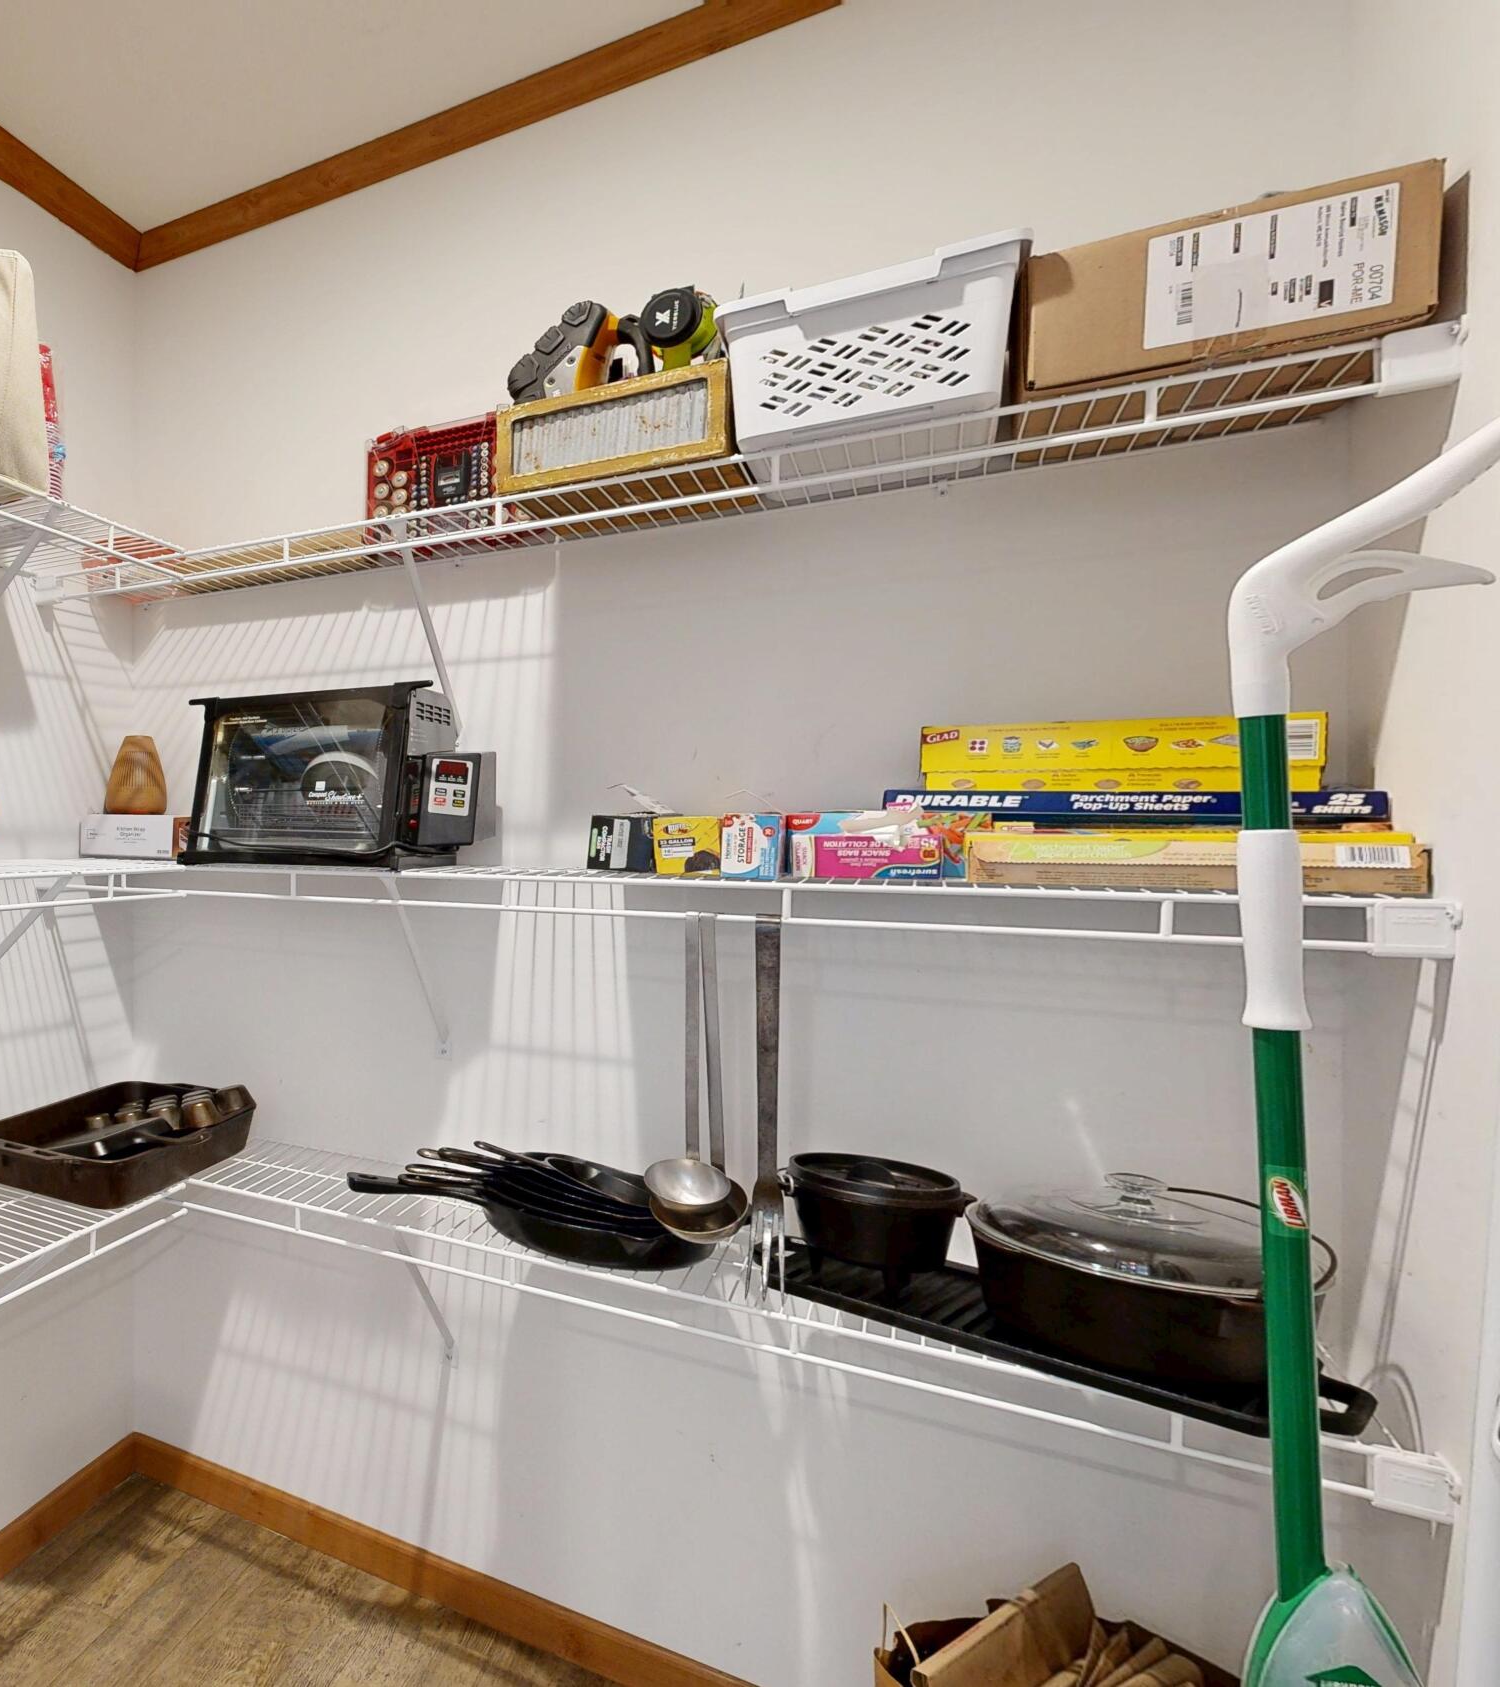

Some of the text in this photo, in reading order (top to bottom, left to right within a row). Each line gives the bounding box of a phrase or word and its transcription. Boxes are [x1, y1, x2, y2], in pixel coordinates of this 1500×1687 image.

[1368, 264, 1384, 301] 00704
[926, 730, 959, 744] GLAD
[895, 794, 1022, 808] DURABLE
[1070, 793, 1211, 805] Parchment Paper
[1329, 794, 1366, 805] 25
[1072, 801, 1190, 812] Pop-Up Sheets
[1312, 805, 1372, 814] SHEETS
[737, 827, 746, 864] STORAGE
[1273, 1180, 1306, 1228] LIBMAN
